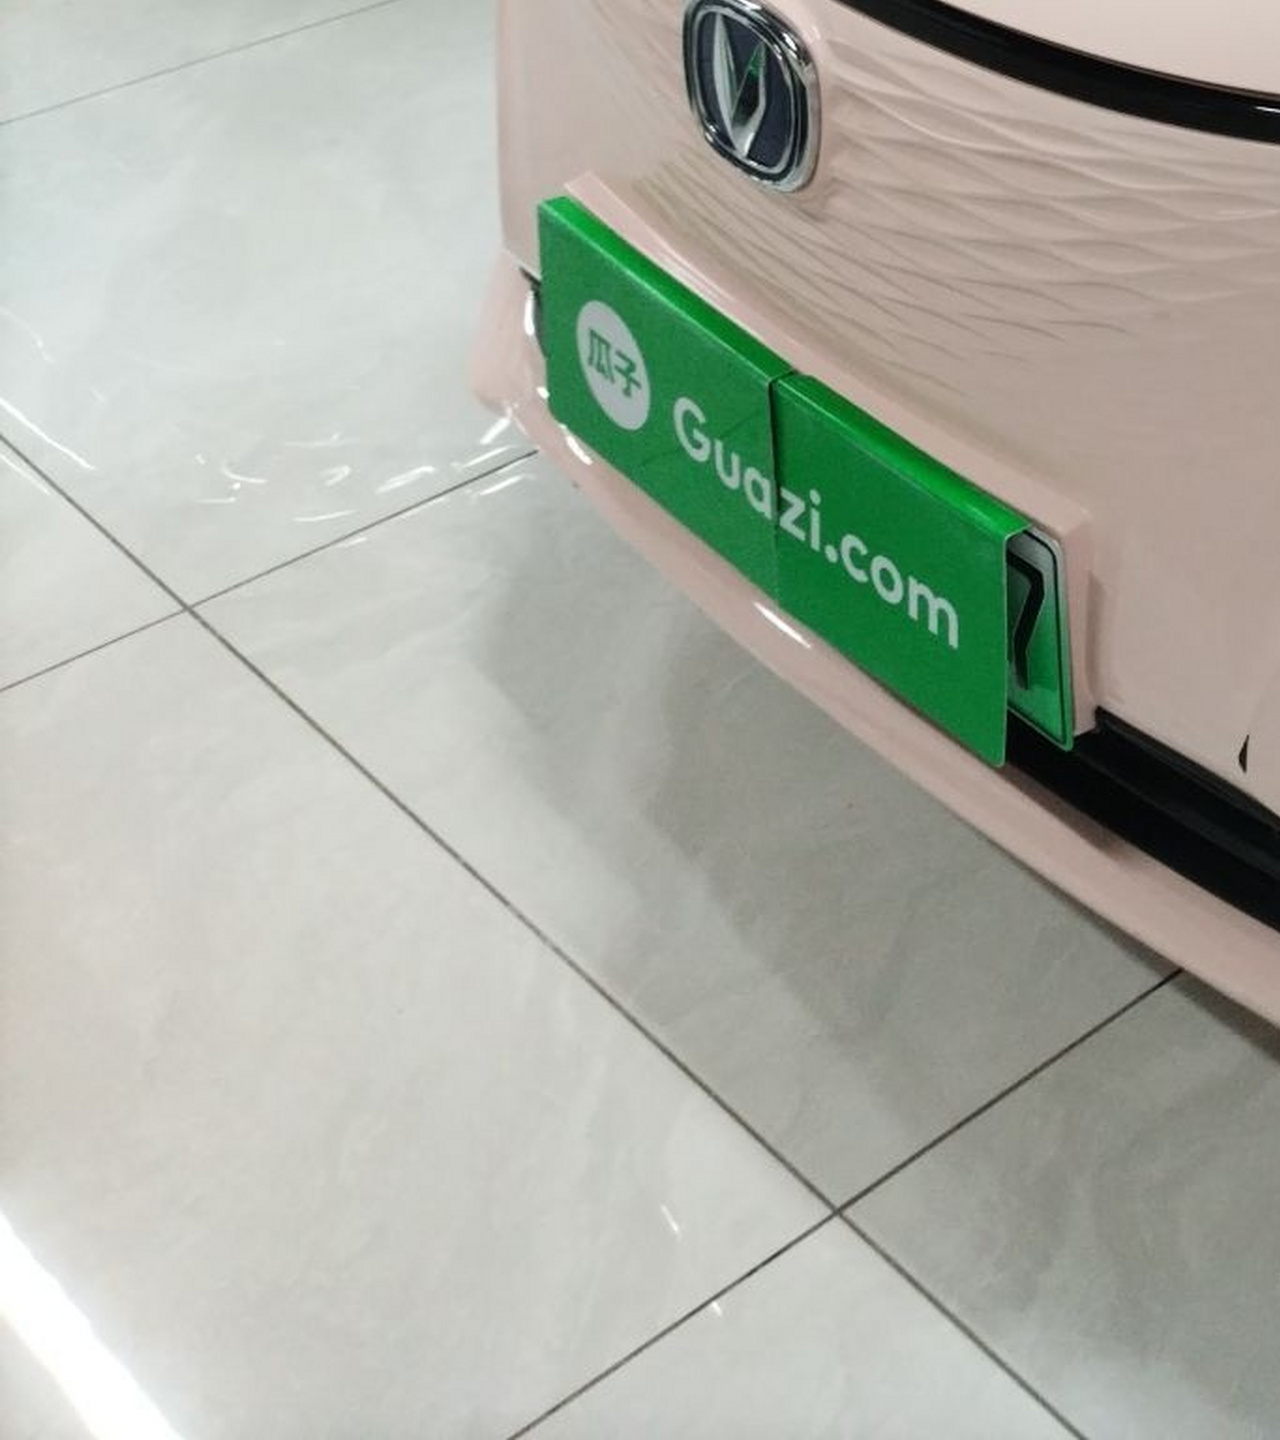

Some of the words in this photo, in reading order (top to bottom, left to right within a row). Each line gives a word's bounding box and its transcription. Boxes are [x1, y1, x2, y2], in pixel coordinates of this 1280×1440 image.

[588, 328, 642, 398] 瓜子
[673, 397, 959, 649] Guazi.com
[1005, 550, 1045, 690] 7
